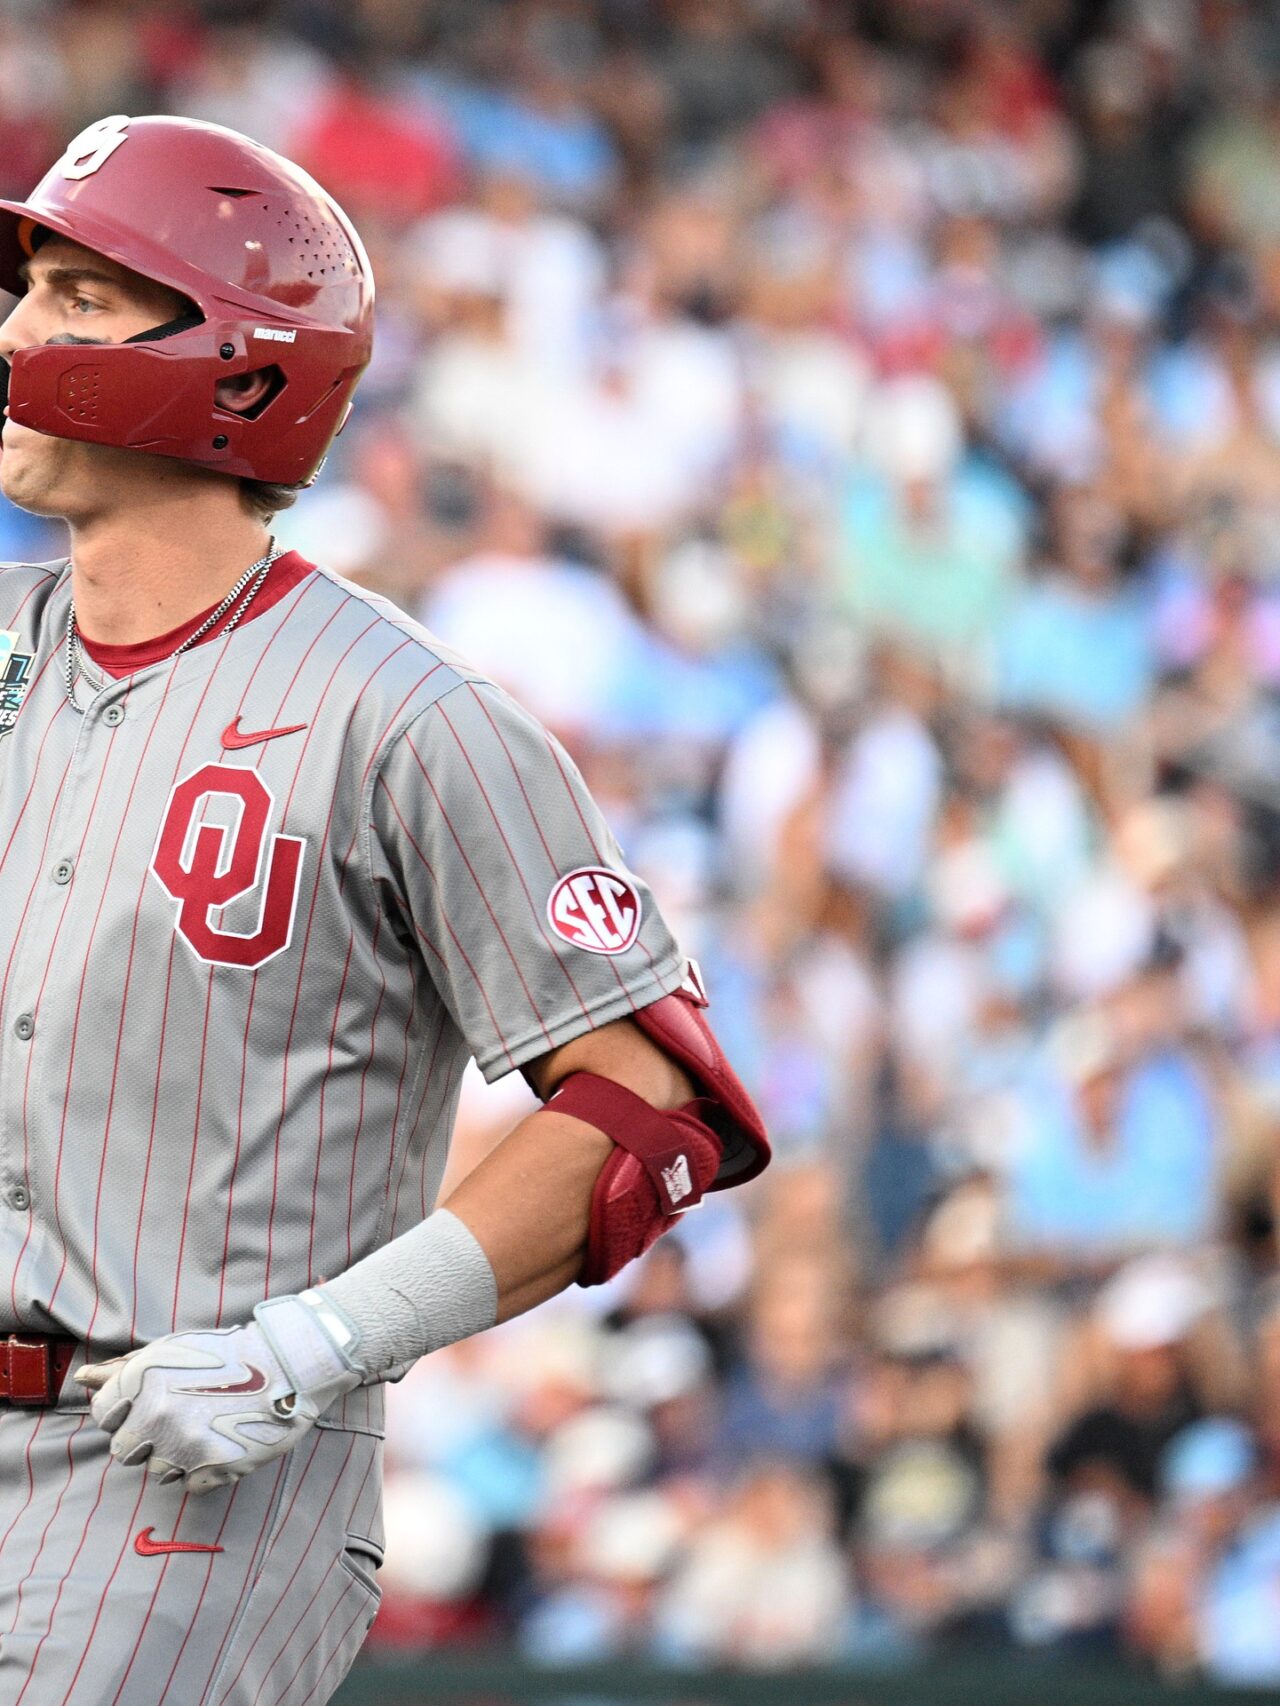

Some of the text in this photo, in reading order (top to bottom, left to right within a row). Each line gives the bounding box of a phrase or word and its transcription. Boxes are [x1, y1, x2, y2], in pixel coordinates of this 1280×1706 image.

[253, 327, 297, 343] marucci
[149, 761, 306, 970] OU
[554, 874, 635, 949] SEC
